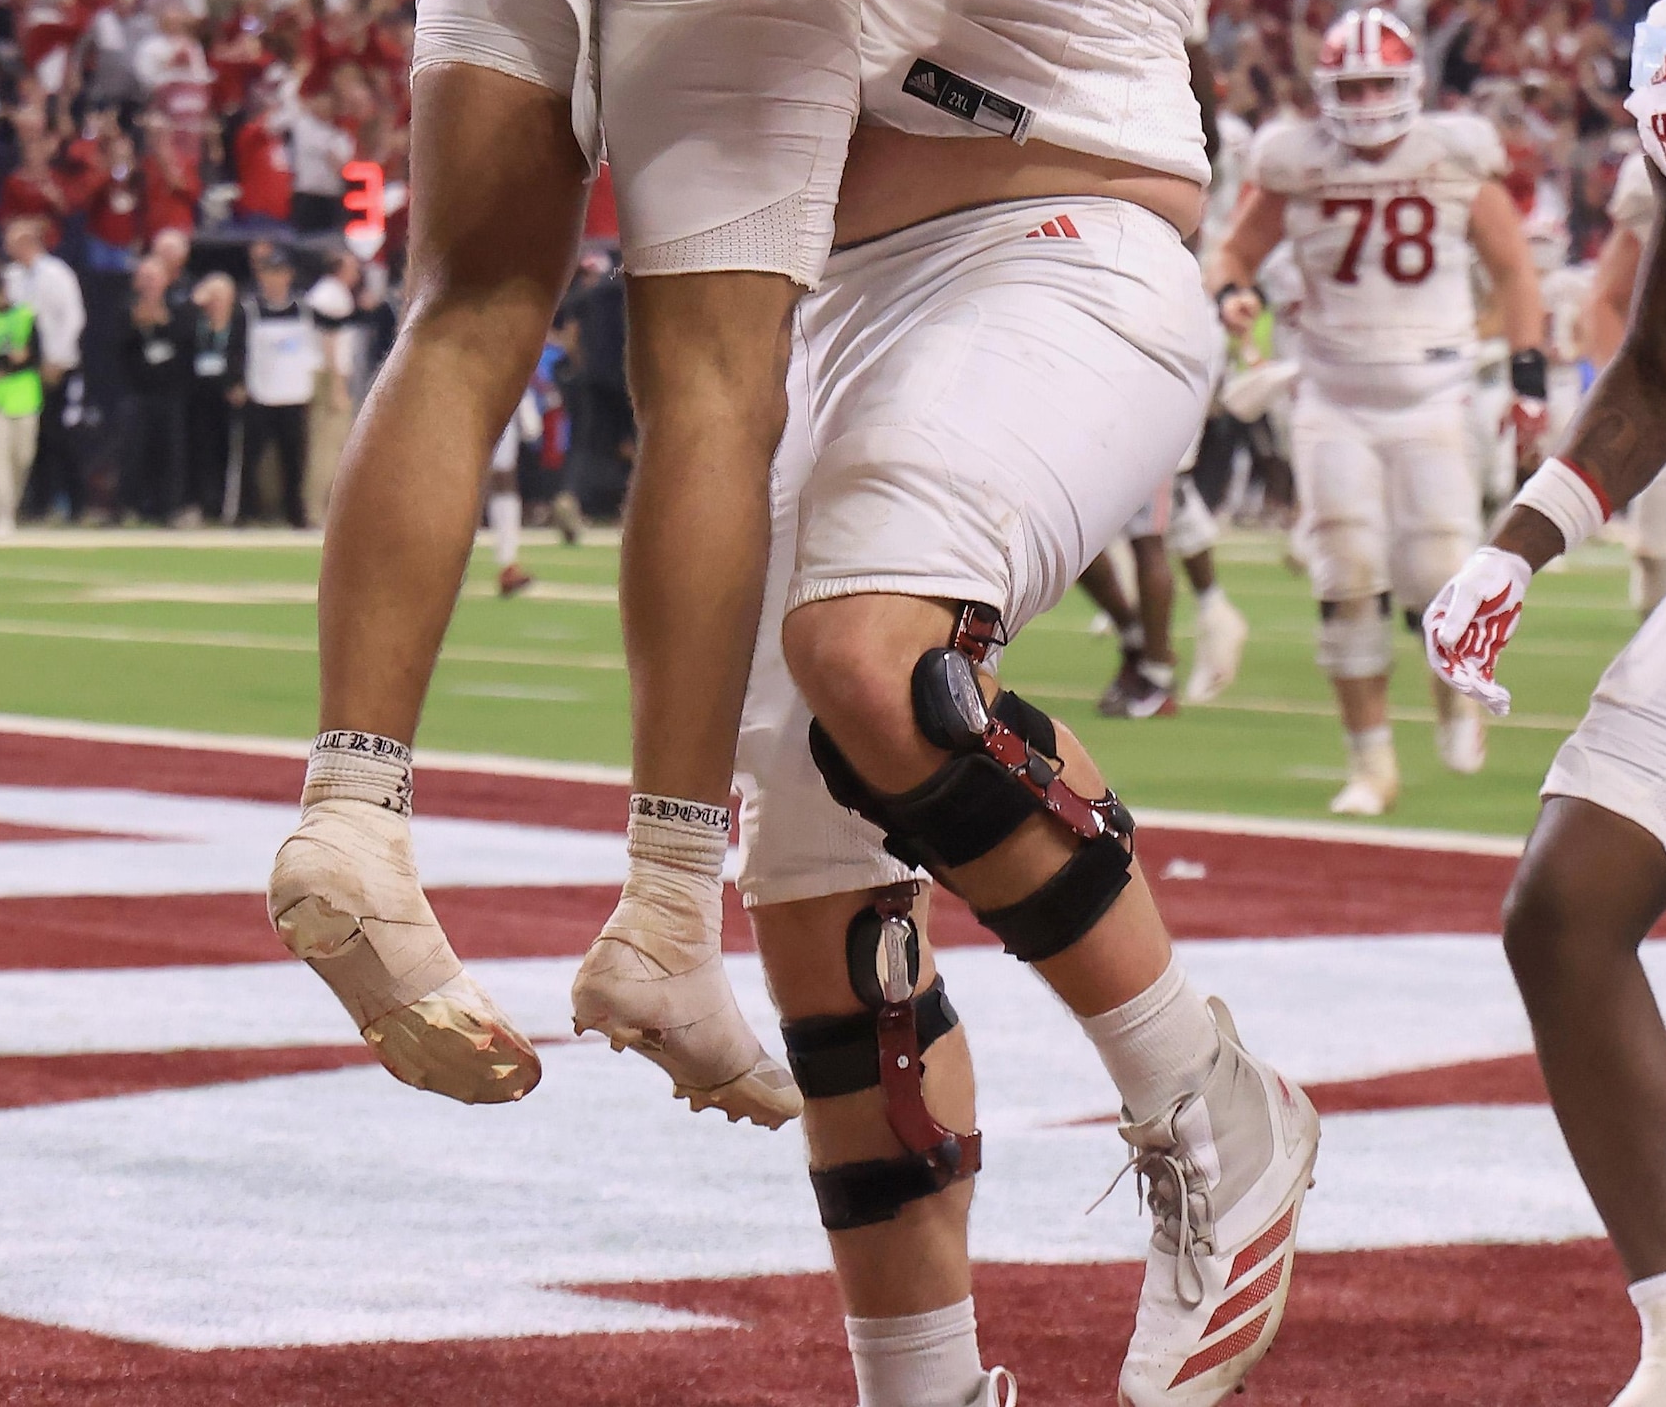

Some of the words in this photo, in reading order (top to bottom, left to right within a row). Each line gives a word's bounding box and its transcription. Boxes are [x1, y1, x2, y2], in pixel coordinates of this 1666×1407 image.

[947, 91, 969, 112] 2XL
[341, 160, 386, 241] 3
[1321, 195, 1436, 285] 78
